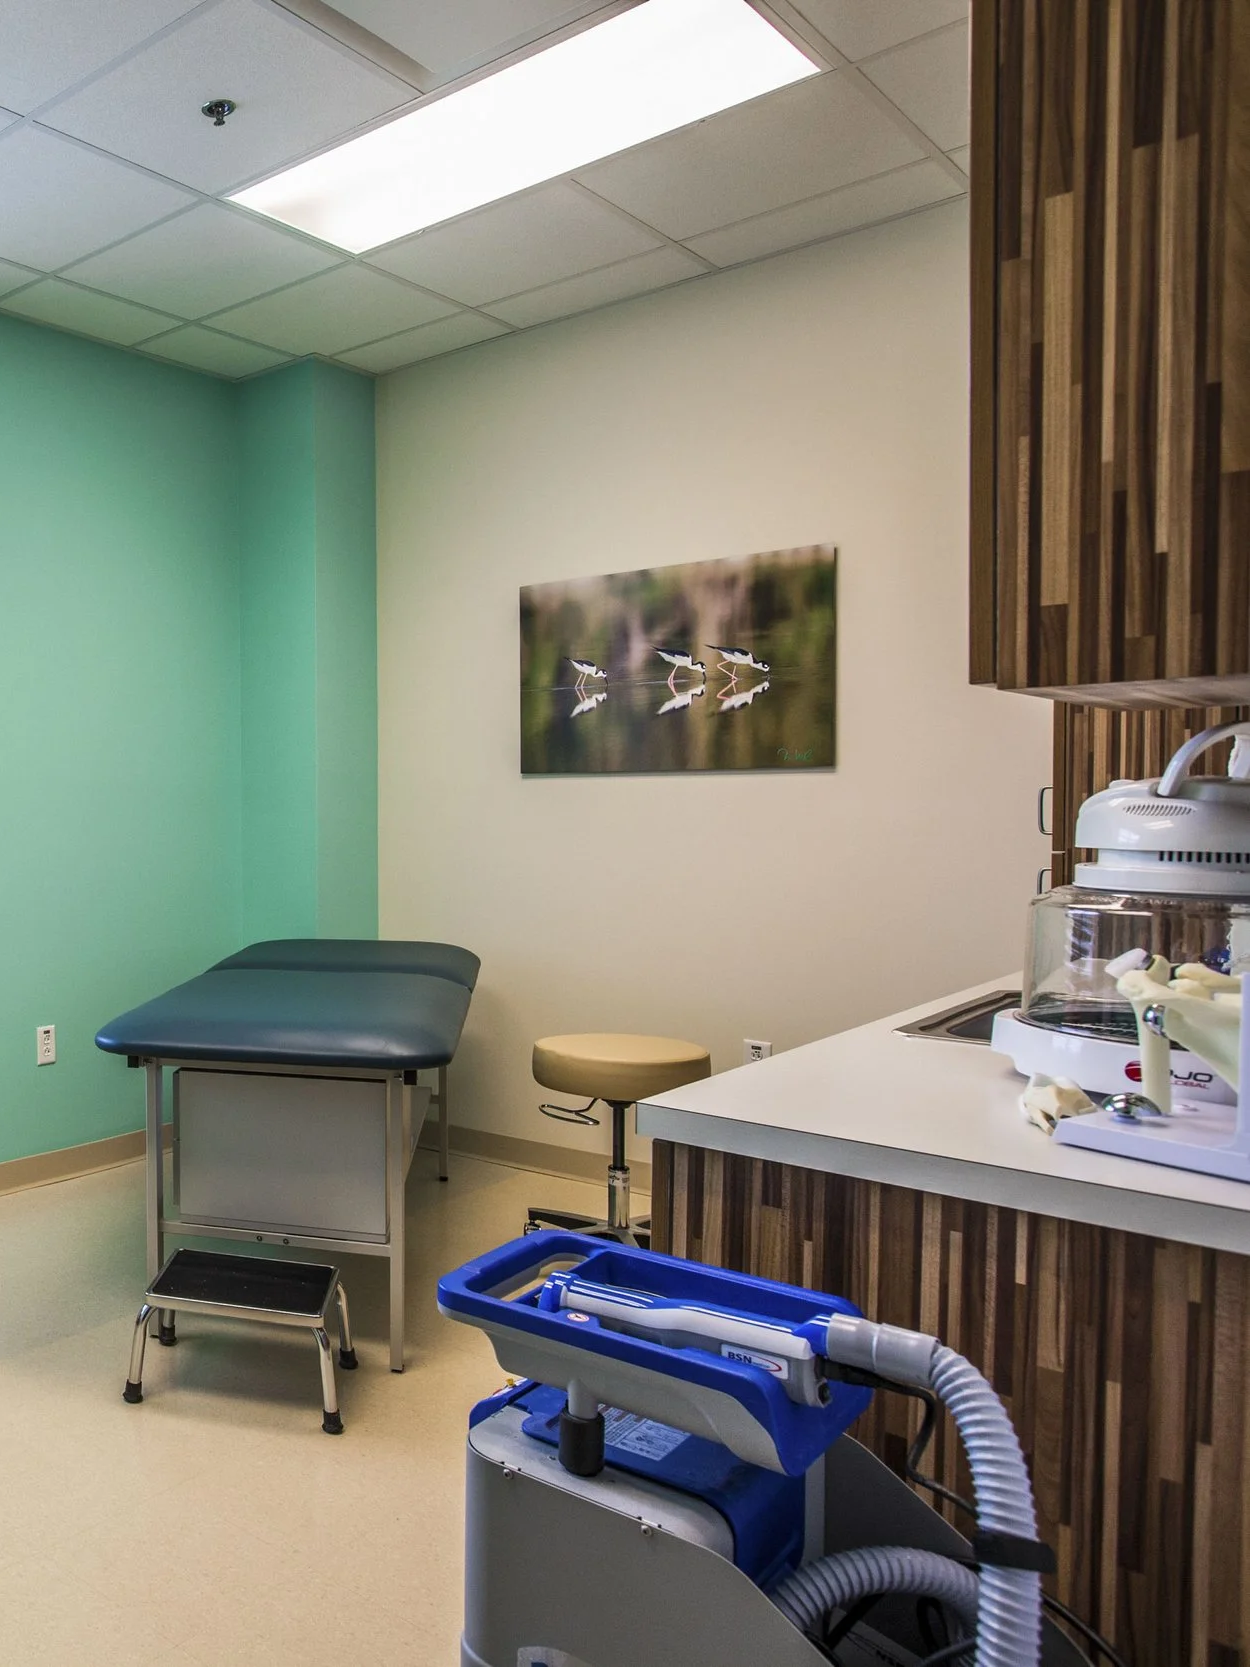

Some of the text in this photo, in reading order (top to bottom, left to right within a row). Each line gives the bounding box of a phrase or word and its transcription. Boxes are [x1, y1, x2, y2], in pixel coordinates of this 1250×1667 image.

[1169, 1069, 1213, 1083] JO
[1170, 1080, 1210, 1090] OBAL
[727, 1351, 752, 1364] BSN
